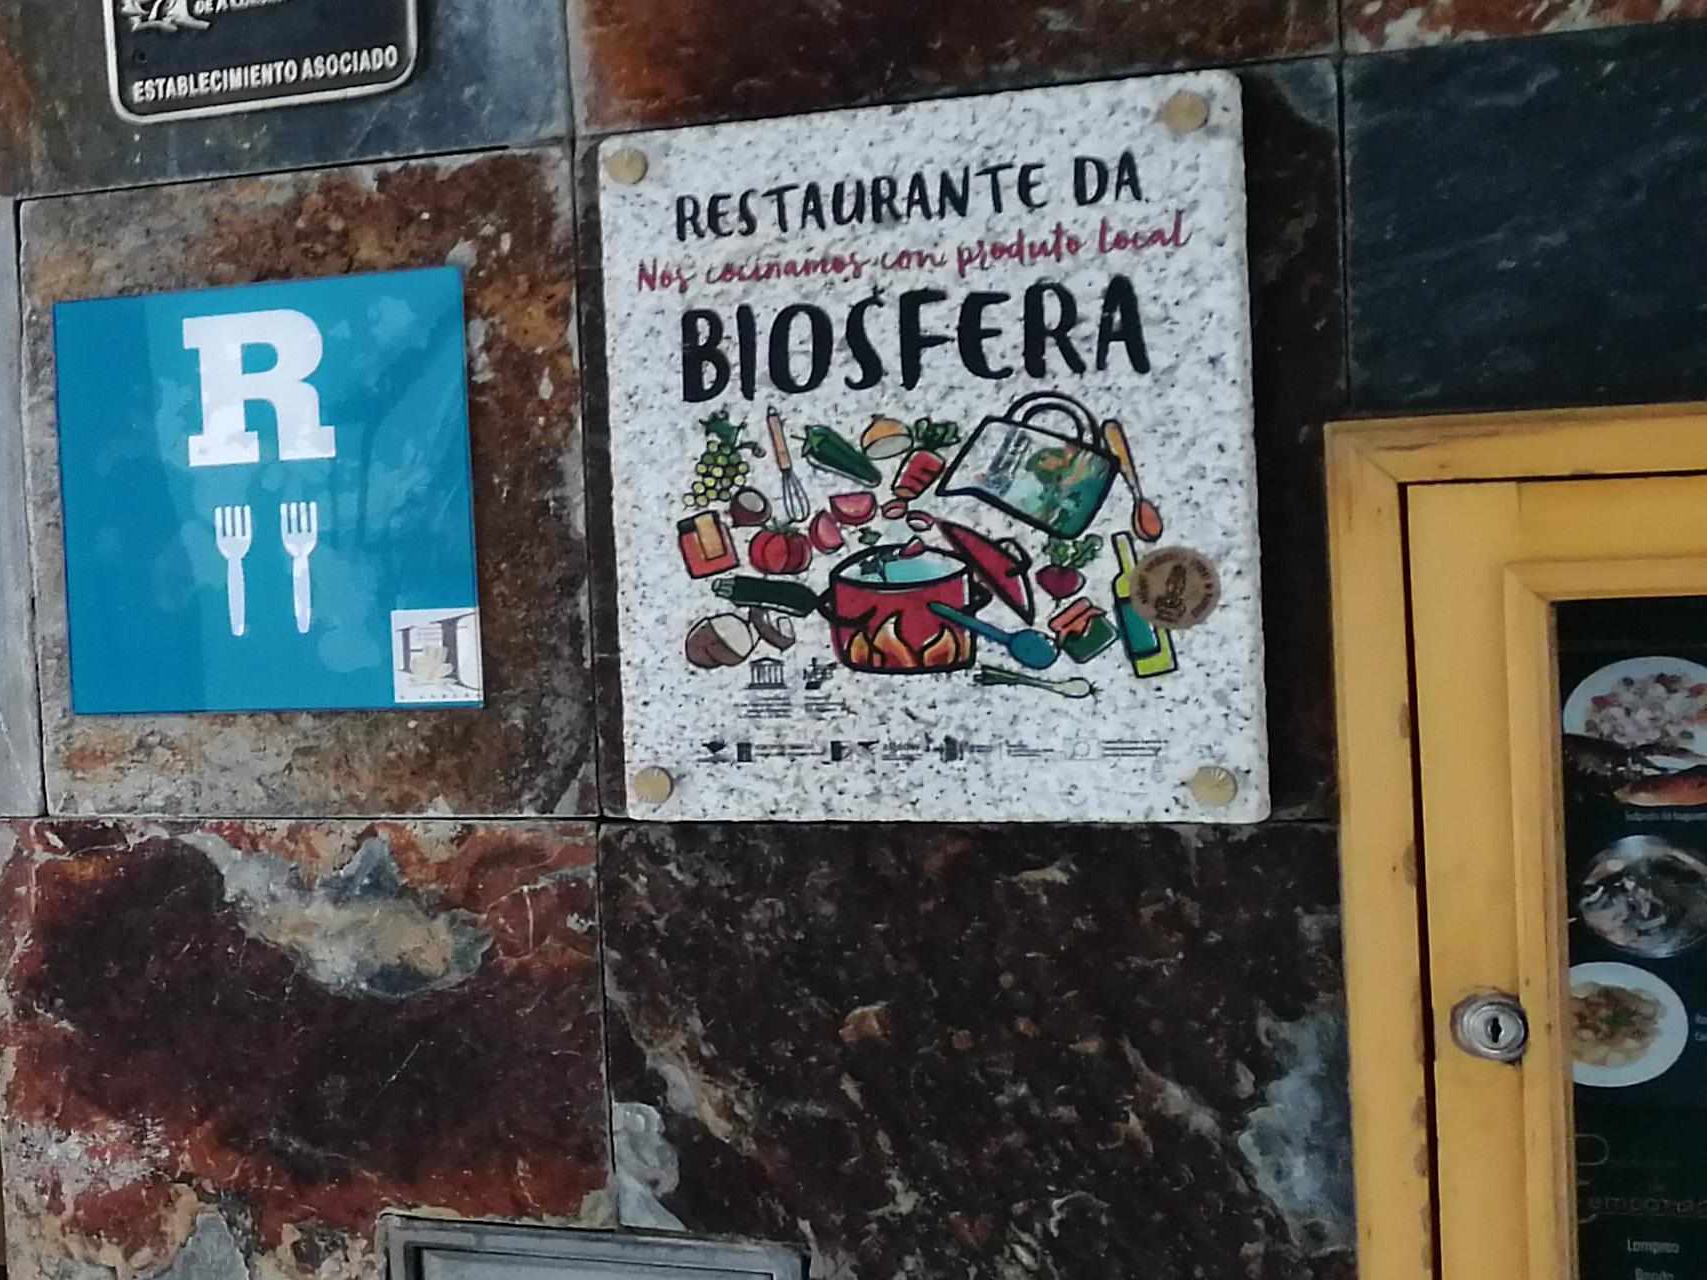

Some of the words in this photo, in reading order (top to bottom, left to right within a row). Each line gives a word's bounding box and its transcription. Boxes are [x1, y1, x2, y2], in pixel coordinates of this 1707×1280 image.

[132, 58, 298, 104] ESTABLECIMIENTO
[301, 45, 398, 82] ASOCIADO
[675, 162, 1048, 241] RESTAURANTE
[1073, 150, 1143, 206] DA
[872, 247, 946, 273] con
[955, 219, 1082, 278] produto
[682, 273, 1150, 405] BIOSFERA
[182, 308, 336, 467] R
